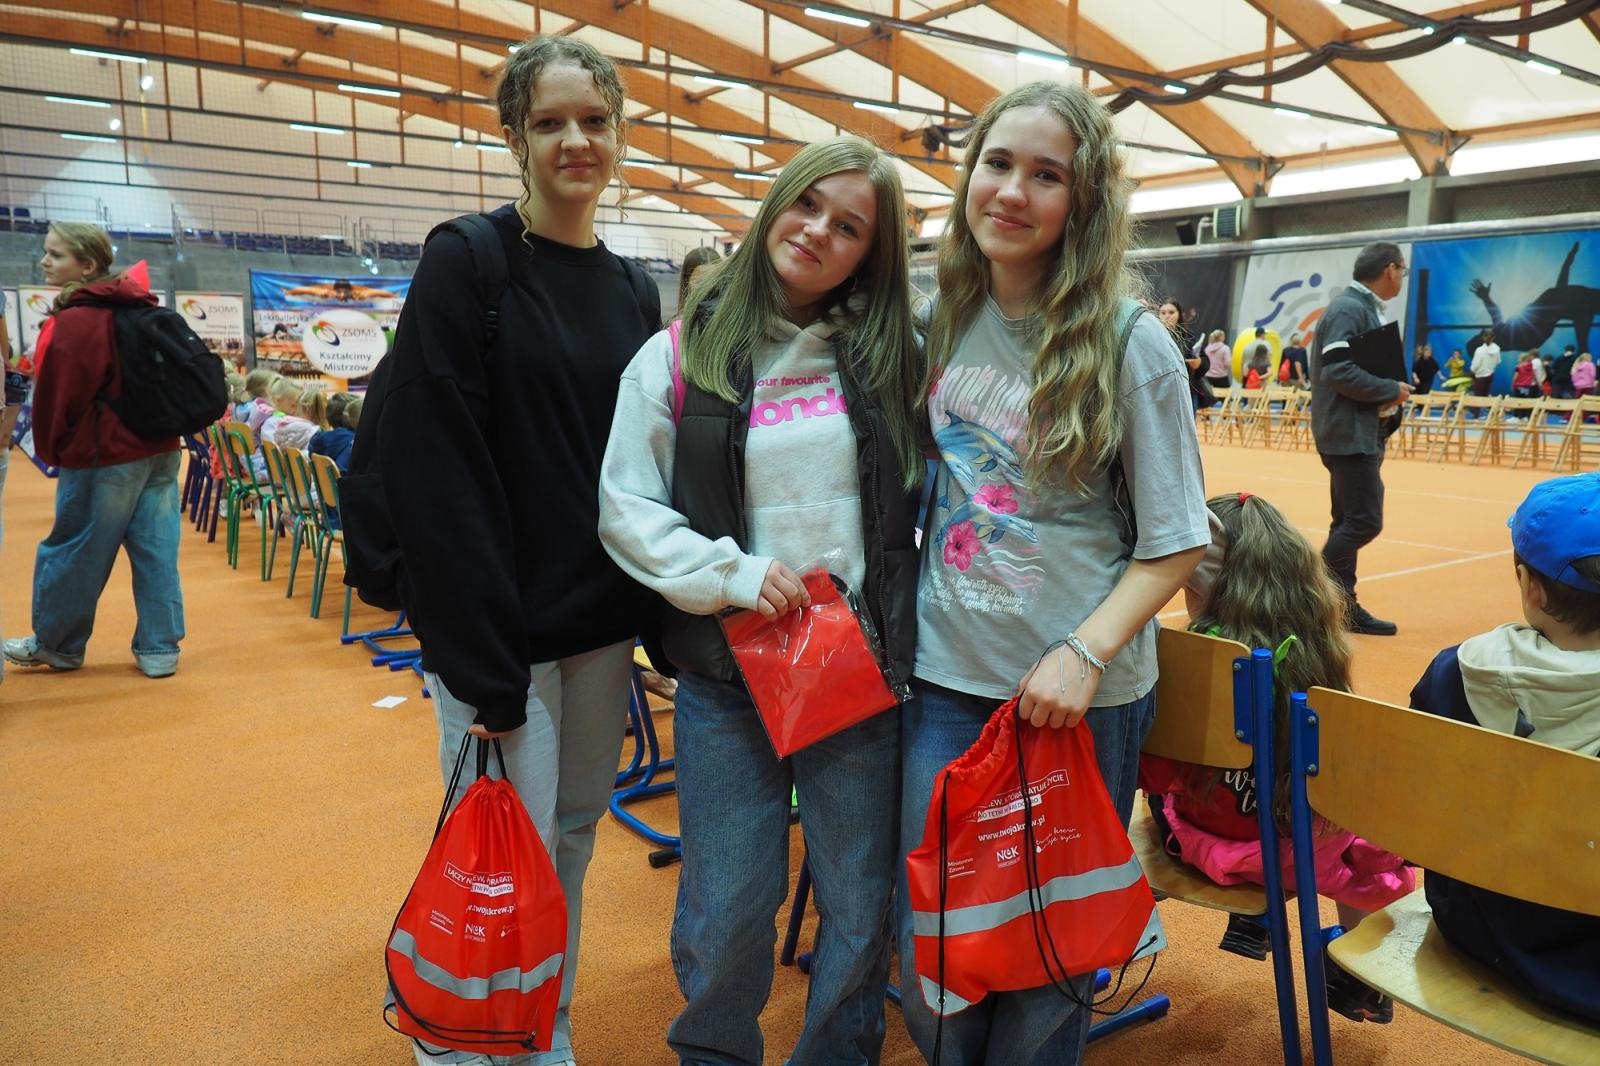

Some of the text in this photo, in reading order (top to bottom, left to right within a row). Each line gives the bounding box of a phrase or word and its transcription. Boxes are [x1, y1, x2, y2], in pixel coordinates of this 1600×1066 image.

[342, 328, 377, 338] ZSOMS
[319, 351, 371, 361] Kształcimy
[753, 375, 831, 388] our favourite
